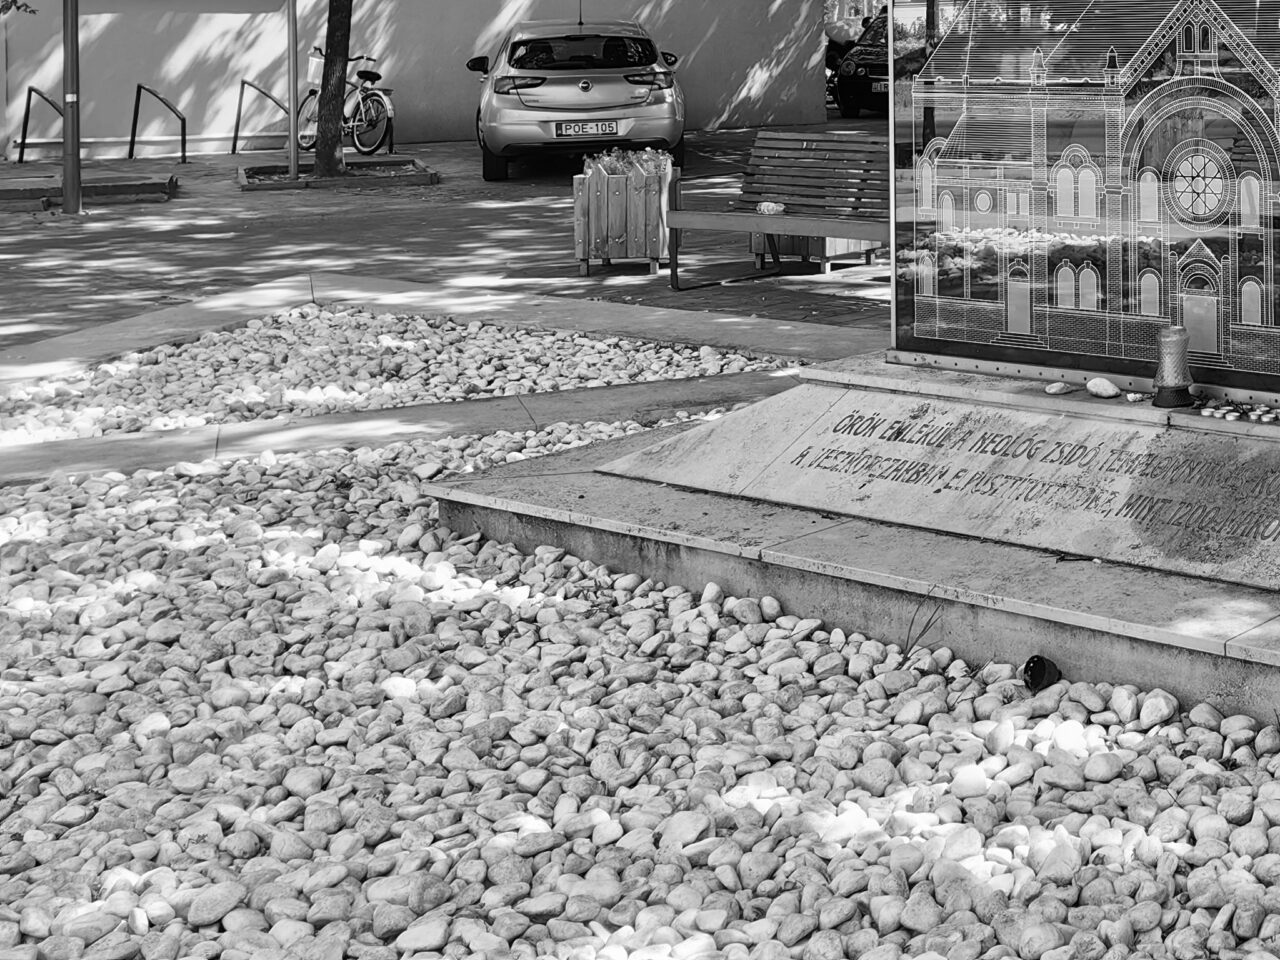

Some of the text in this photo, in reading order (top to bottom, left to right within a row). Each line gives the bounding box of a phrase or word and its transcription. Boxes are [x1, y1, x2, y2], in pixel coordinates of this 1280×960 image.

[564, 123, 614, 134] POE-105
[832, 410, 886, 438] ÖRÖK
[877, 417, 955, 448] EMLÉKÜL
[951, 431, 972, 450] A
[967, 431, 1047, 460] NEOLÓG
[1039, 441, 1105, 468] ZSIDÓ
[790, 445, 814, 466] A
[1114, 493, 1173, 524] MINT
[1166, 501, 1221, 530] 1200
